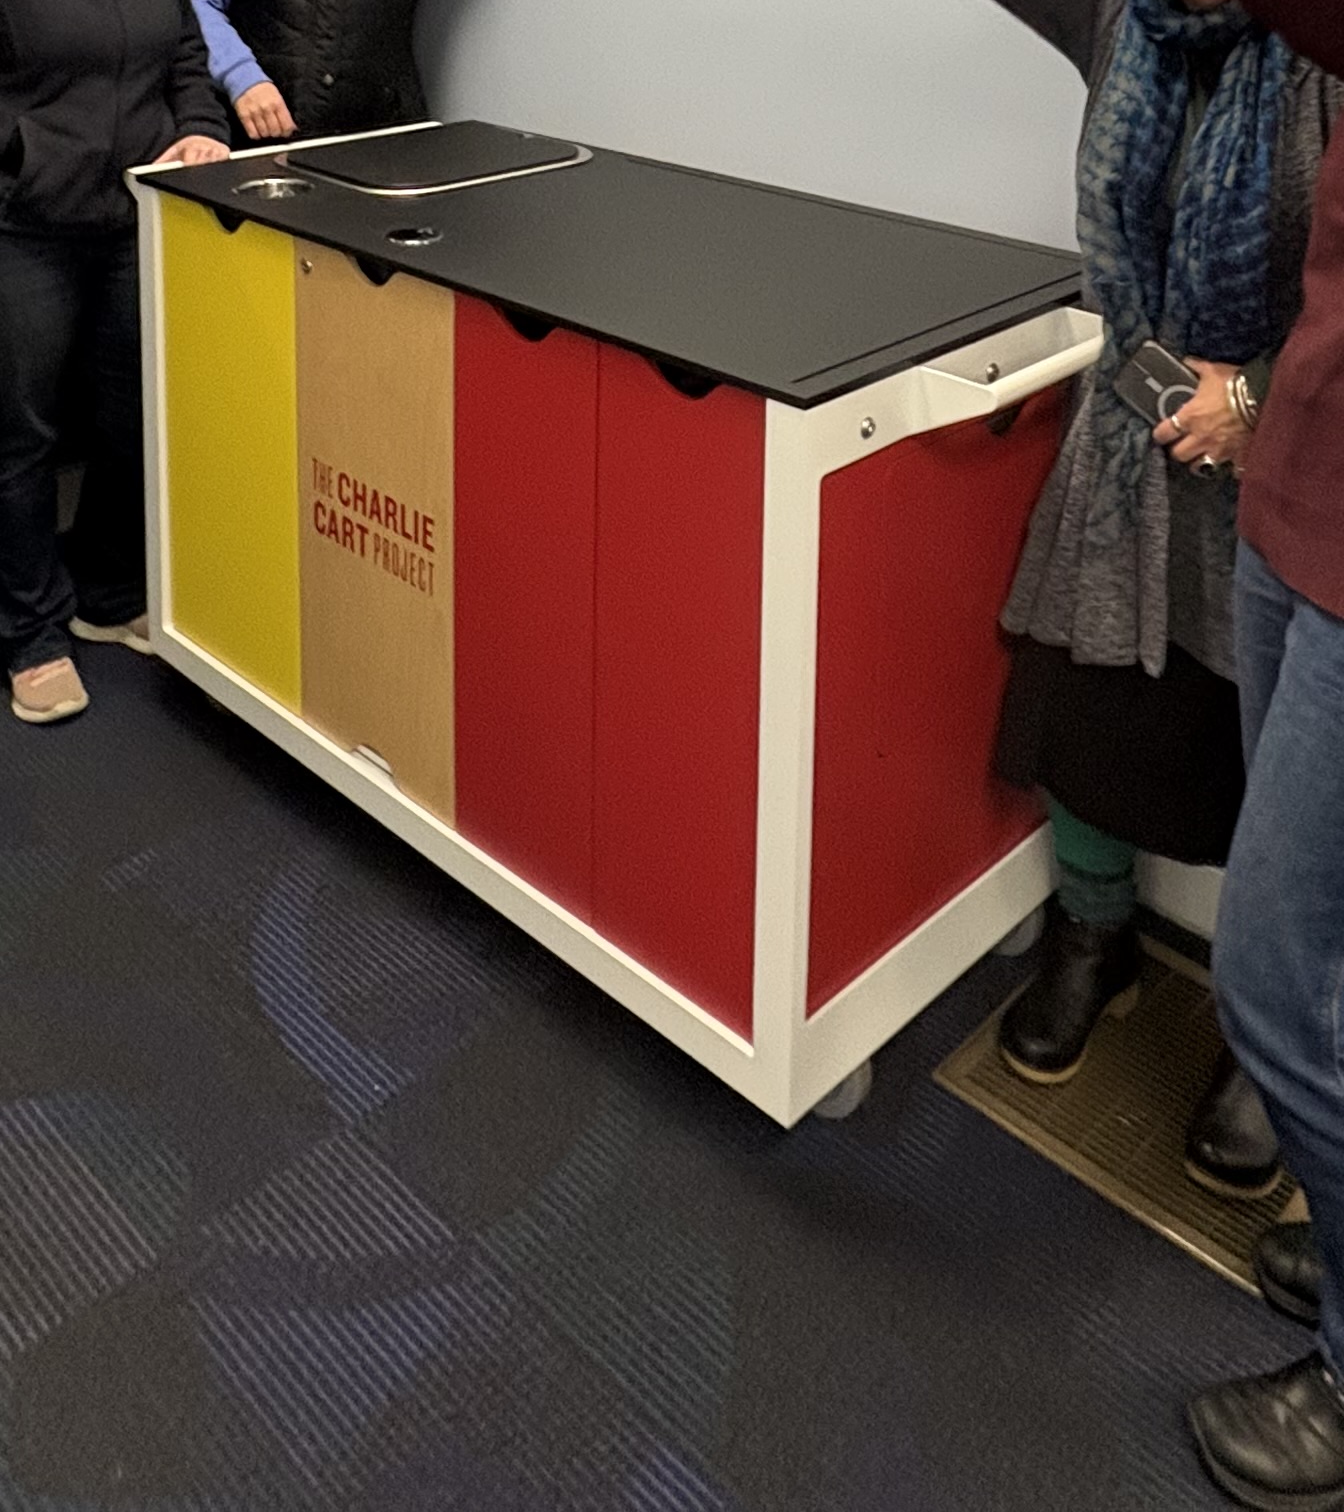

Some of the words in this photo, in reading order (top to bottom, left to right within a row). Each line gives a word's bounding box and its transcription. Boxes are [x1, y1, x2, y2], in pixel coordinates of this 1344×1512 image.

[312, 457, 334, 499] THE
[337, 472, 435, 553] CHARLIE
[313, 500, 370, 558] CART
[373, 532, 435, 597] PROJECT
